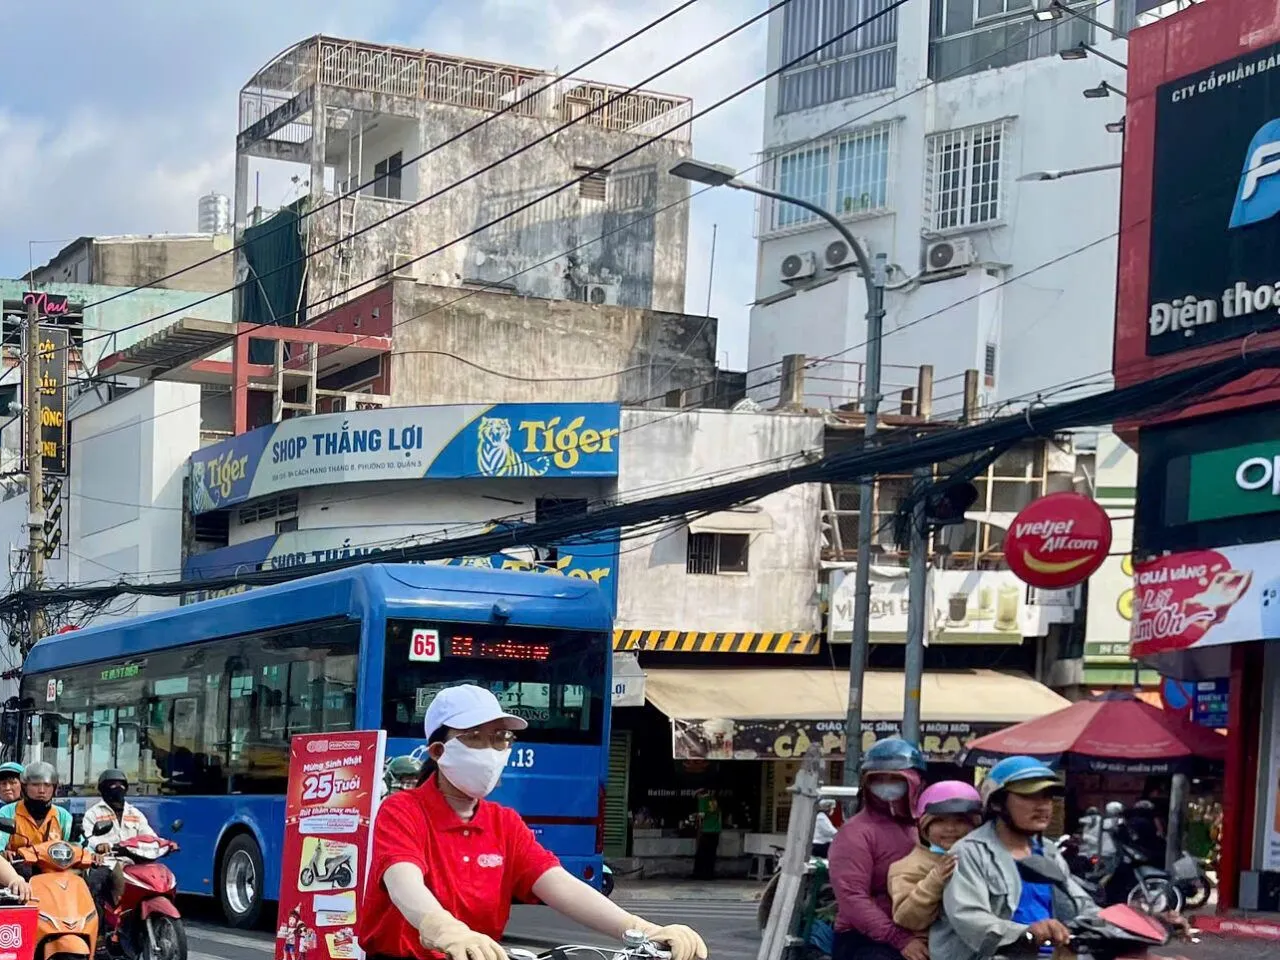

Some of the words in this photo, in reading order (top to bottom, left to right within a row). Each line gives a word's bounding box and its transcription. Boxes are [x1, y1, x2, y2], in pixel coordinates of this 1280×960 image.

[1171, 83, 1196, 102] CTY
[1149, 294, 1217, 338] Điện
[272, 436, 308, 464] SHOP
[312, 420, 382, 457] THẮNG
[388, 424, 423, 458] LỢI
[519, 416, 620, 469] Tiger
[207, 450, 248, 498] Tiger
[413, 633, 436, 656] 65
[325, 759, 342, 769] Sinh
[343, 755, 362, 767] Nhật
[302, 774, 333, 800] 25
[335, 774, 361, 793] Tuổi
